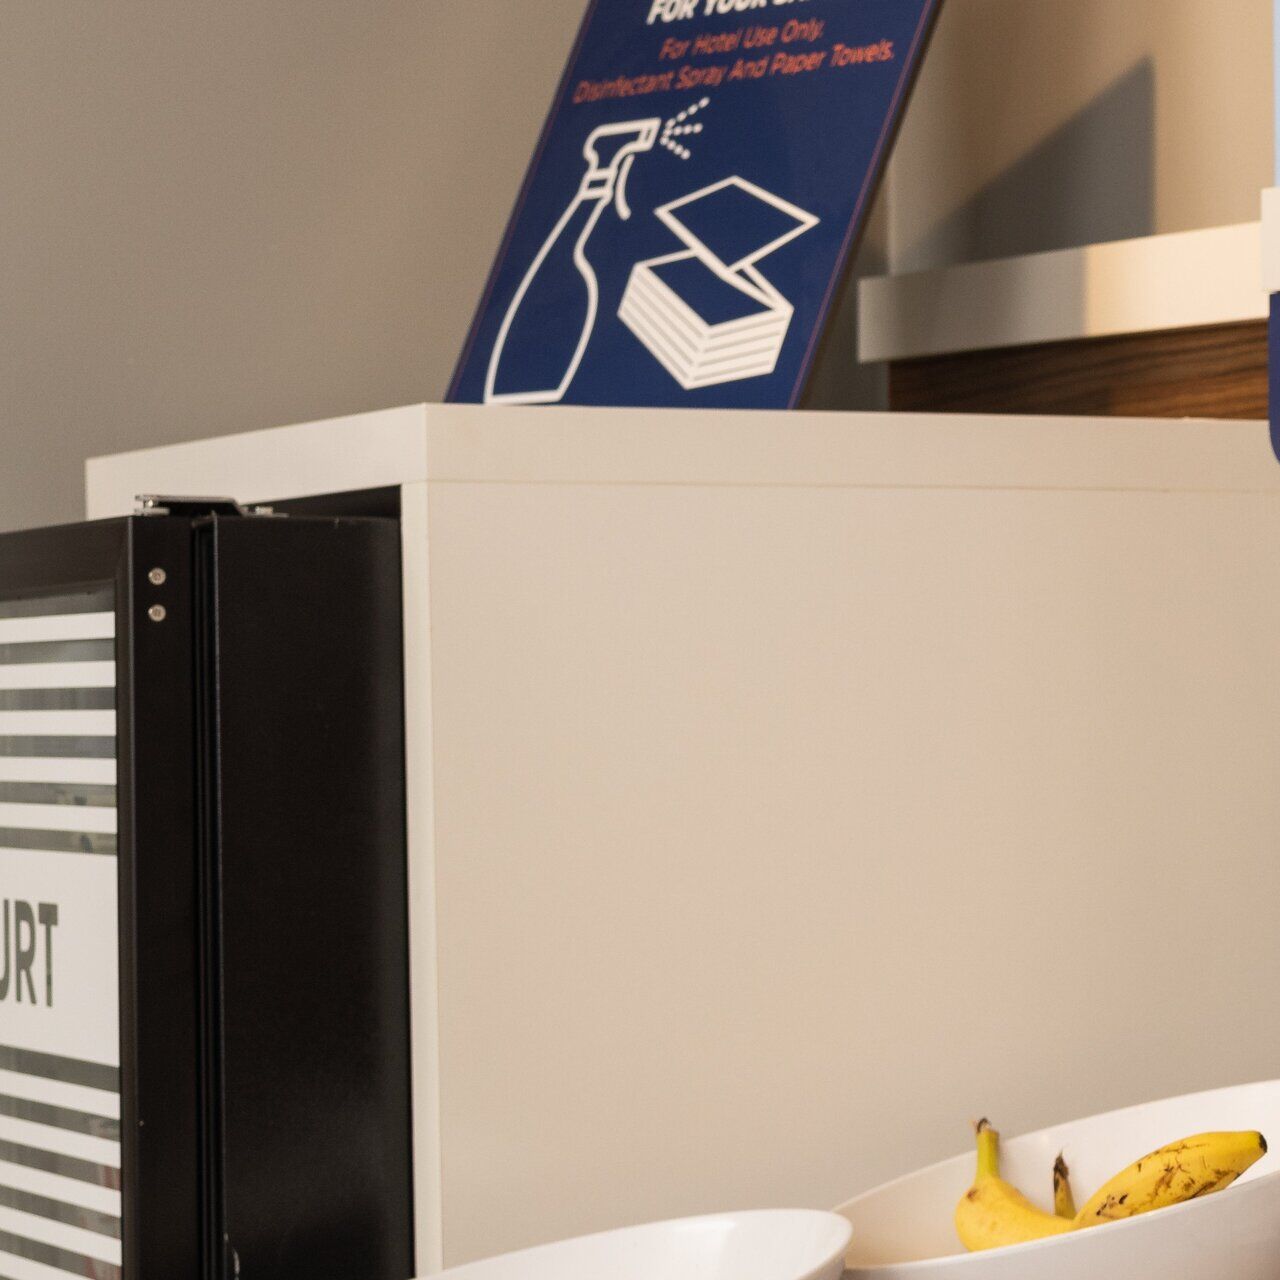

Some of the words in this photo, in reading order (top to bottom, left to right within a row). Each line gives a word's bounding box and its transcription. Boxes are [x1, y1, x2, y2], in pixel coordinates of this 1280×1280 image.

[659, 37, 690, 59] For
[692, 28, 742, 54] Hotel
[743, 26, 779, 48] Use
[572, 71, 674, 104] Disinfectant
[675, 65, 728, 90] Spray
[728, 57, 770, 81] And
[770, 51, 826, 75] Paper
